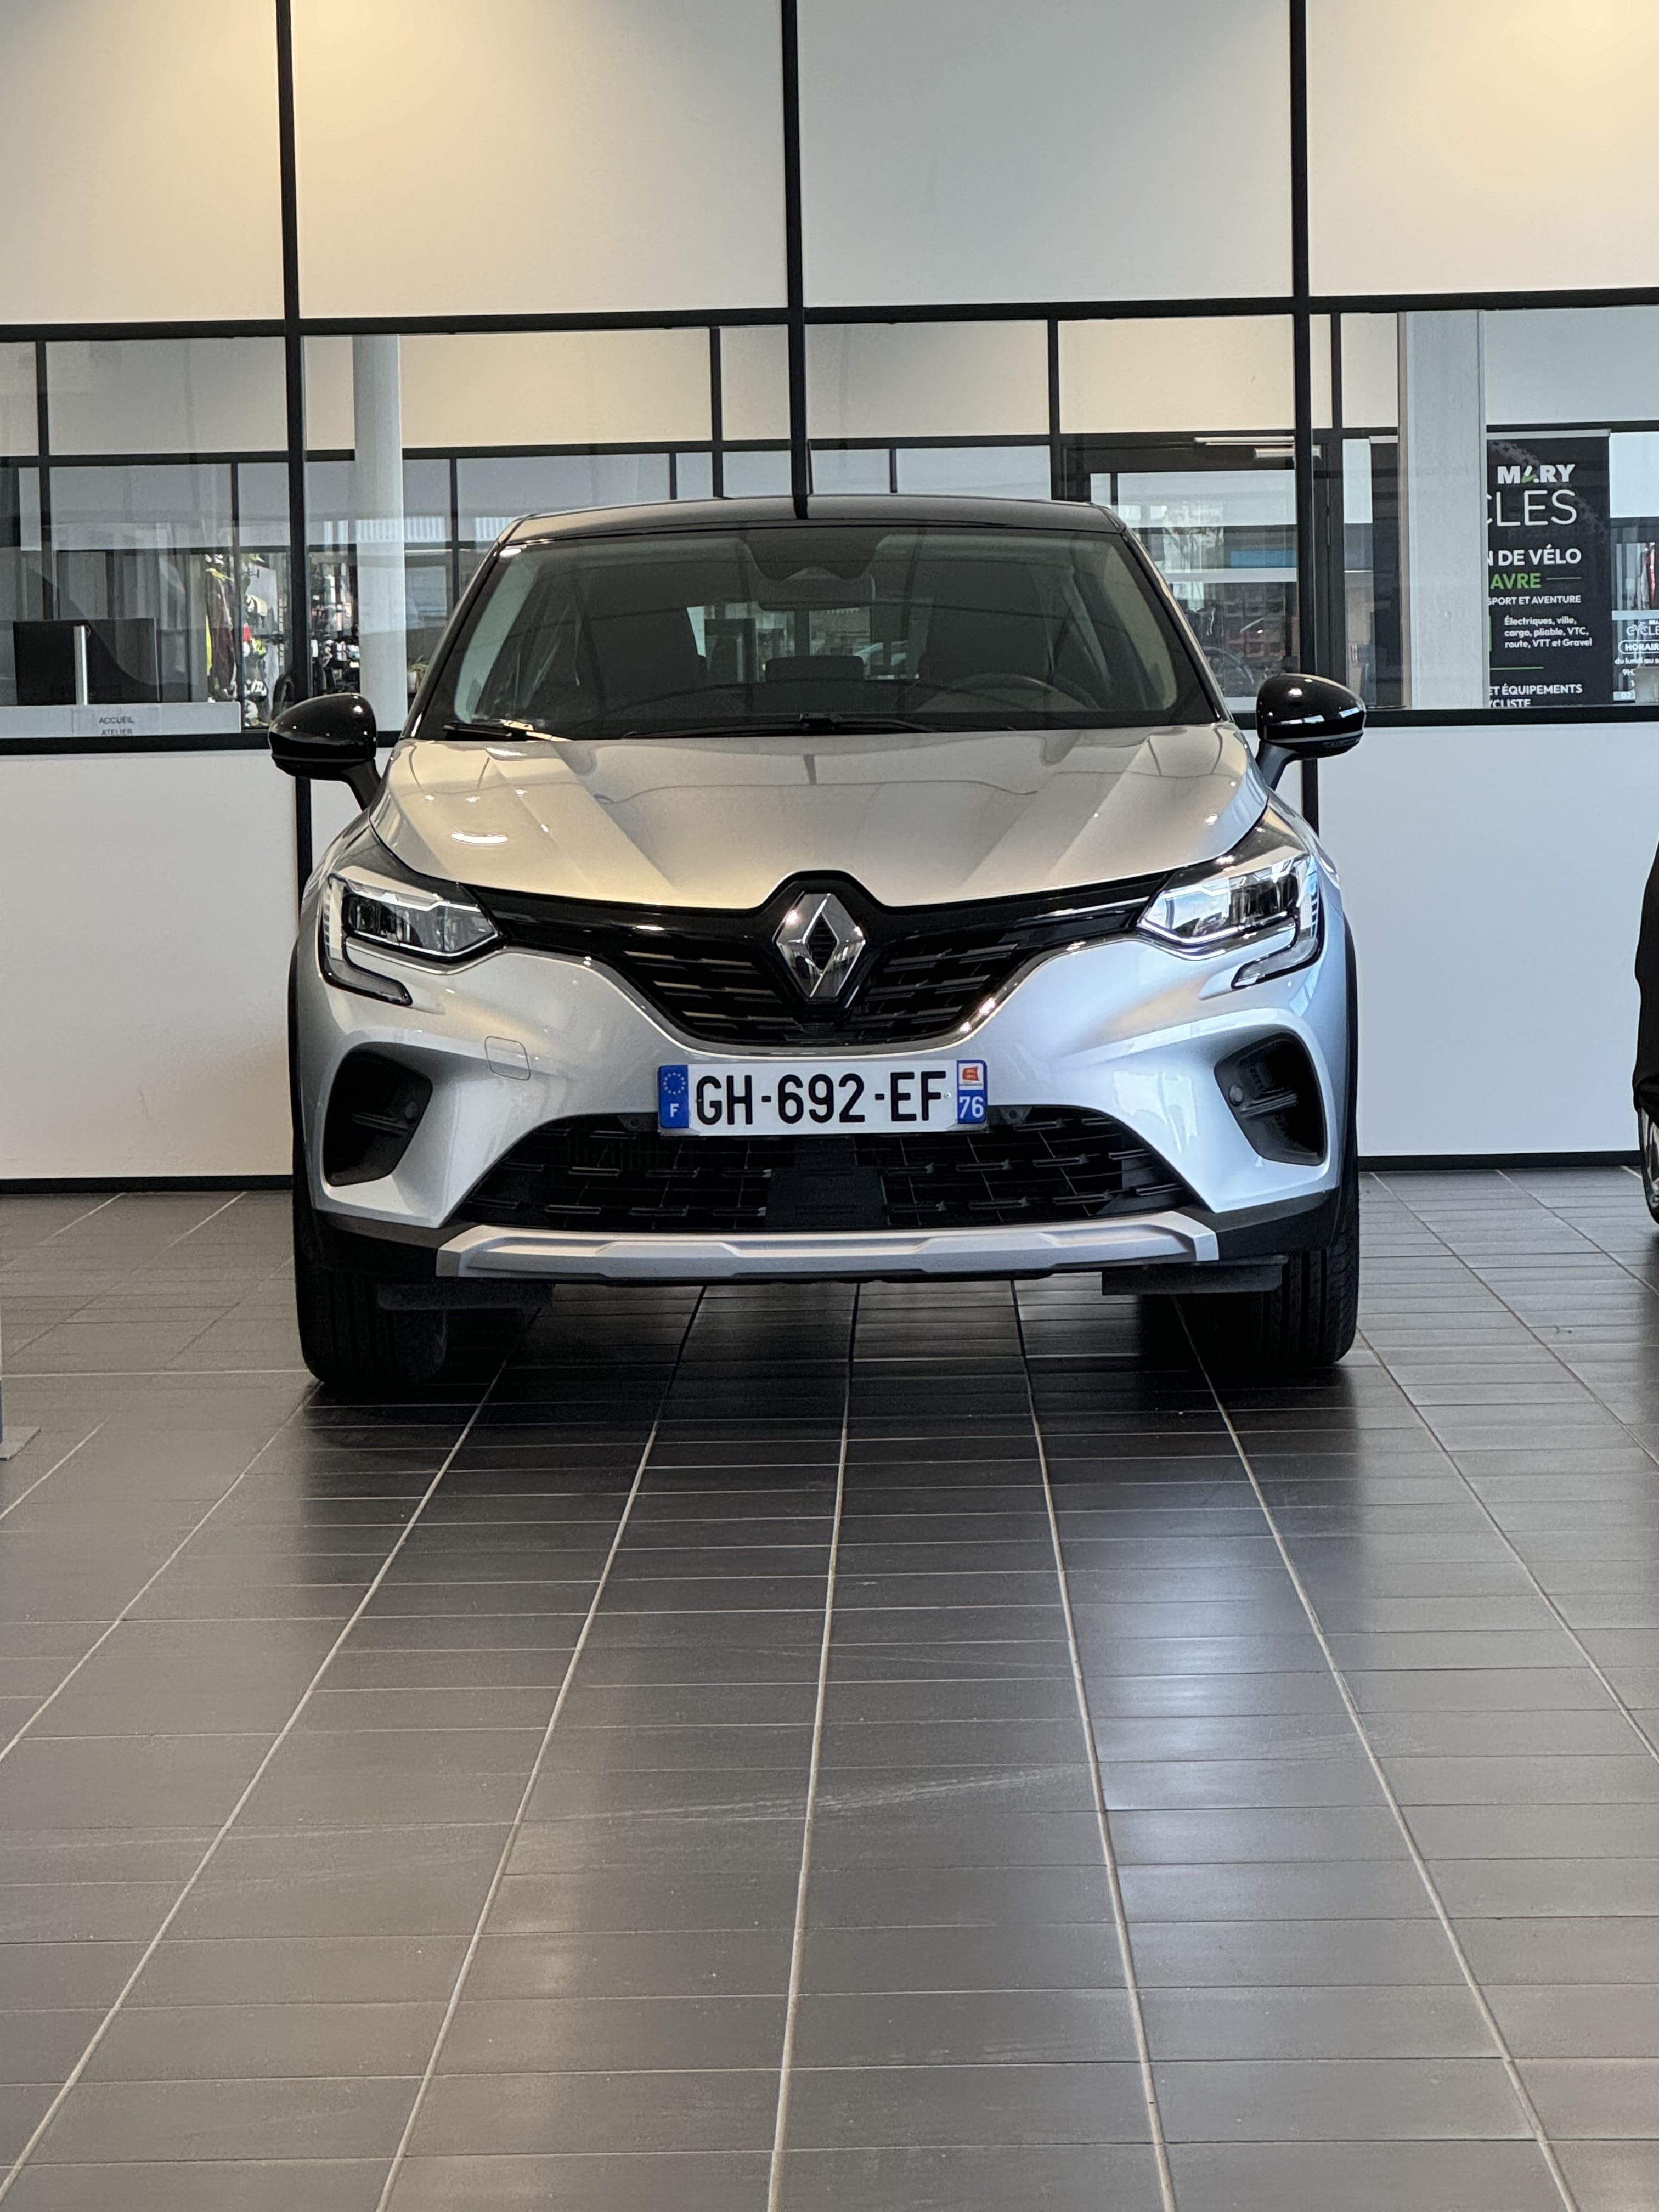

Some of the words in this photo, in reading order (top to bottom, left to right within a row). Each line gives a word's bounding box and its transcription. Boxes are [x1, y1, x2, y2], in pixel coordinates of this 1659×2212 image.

[1497, 464, 1575, 484] MARY
[1487, 489, 1577, 526] LES
[1498, 550, 1525, 566] DE
[1528, 544, 1582, 565] VÉLO
[1490, 573, 1541, 589] AVRE
[1519, 596, 1530, 605] ET
[1532, 595, 1582, 604] AVENTURE
[1504, 614, 1555, 627] Électriques,
[1556, 616, 1577, 625] ville,
[1504, 630, 1532, 638] cargo,
[1533, 628, 1566, 637] pliable,
[1567, 627, 1589, 636] VTC,
[1504, 640, 1531, 649] route,
[1532, 639, 1551, 647] VTT
[1562, 637, 1593, 647] Gravel
[1502, 683, 1583, 695] ÉQUIPEMENTS
[696, 1071, 947, 1125] GH-692-EF
[670, 1103, 679, 1117] F
[959, 1096, 984, 1118] 76
